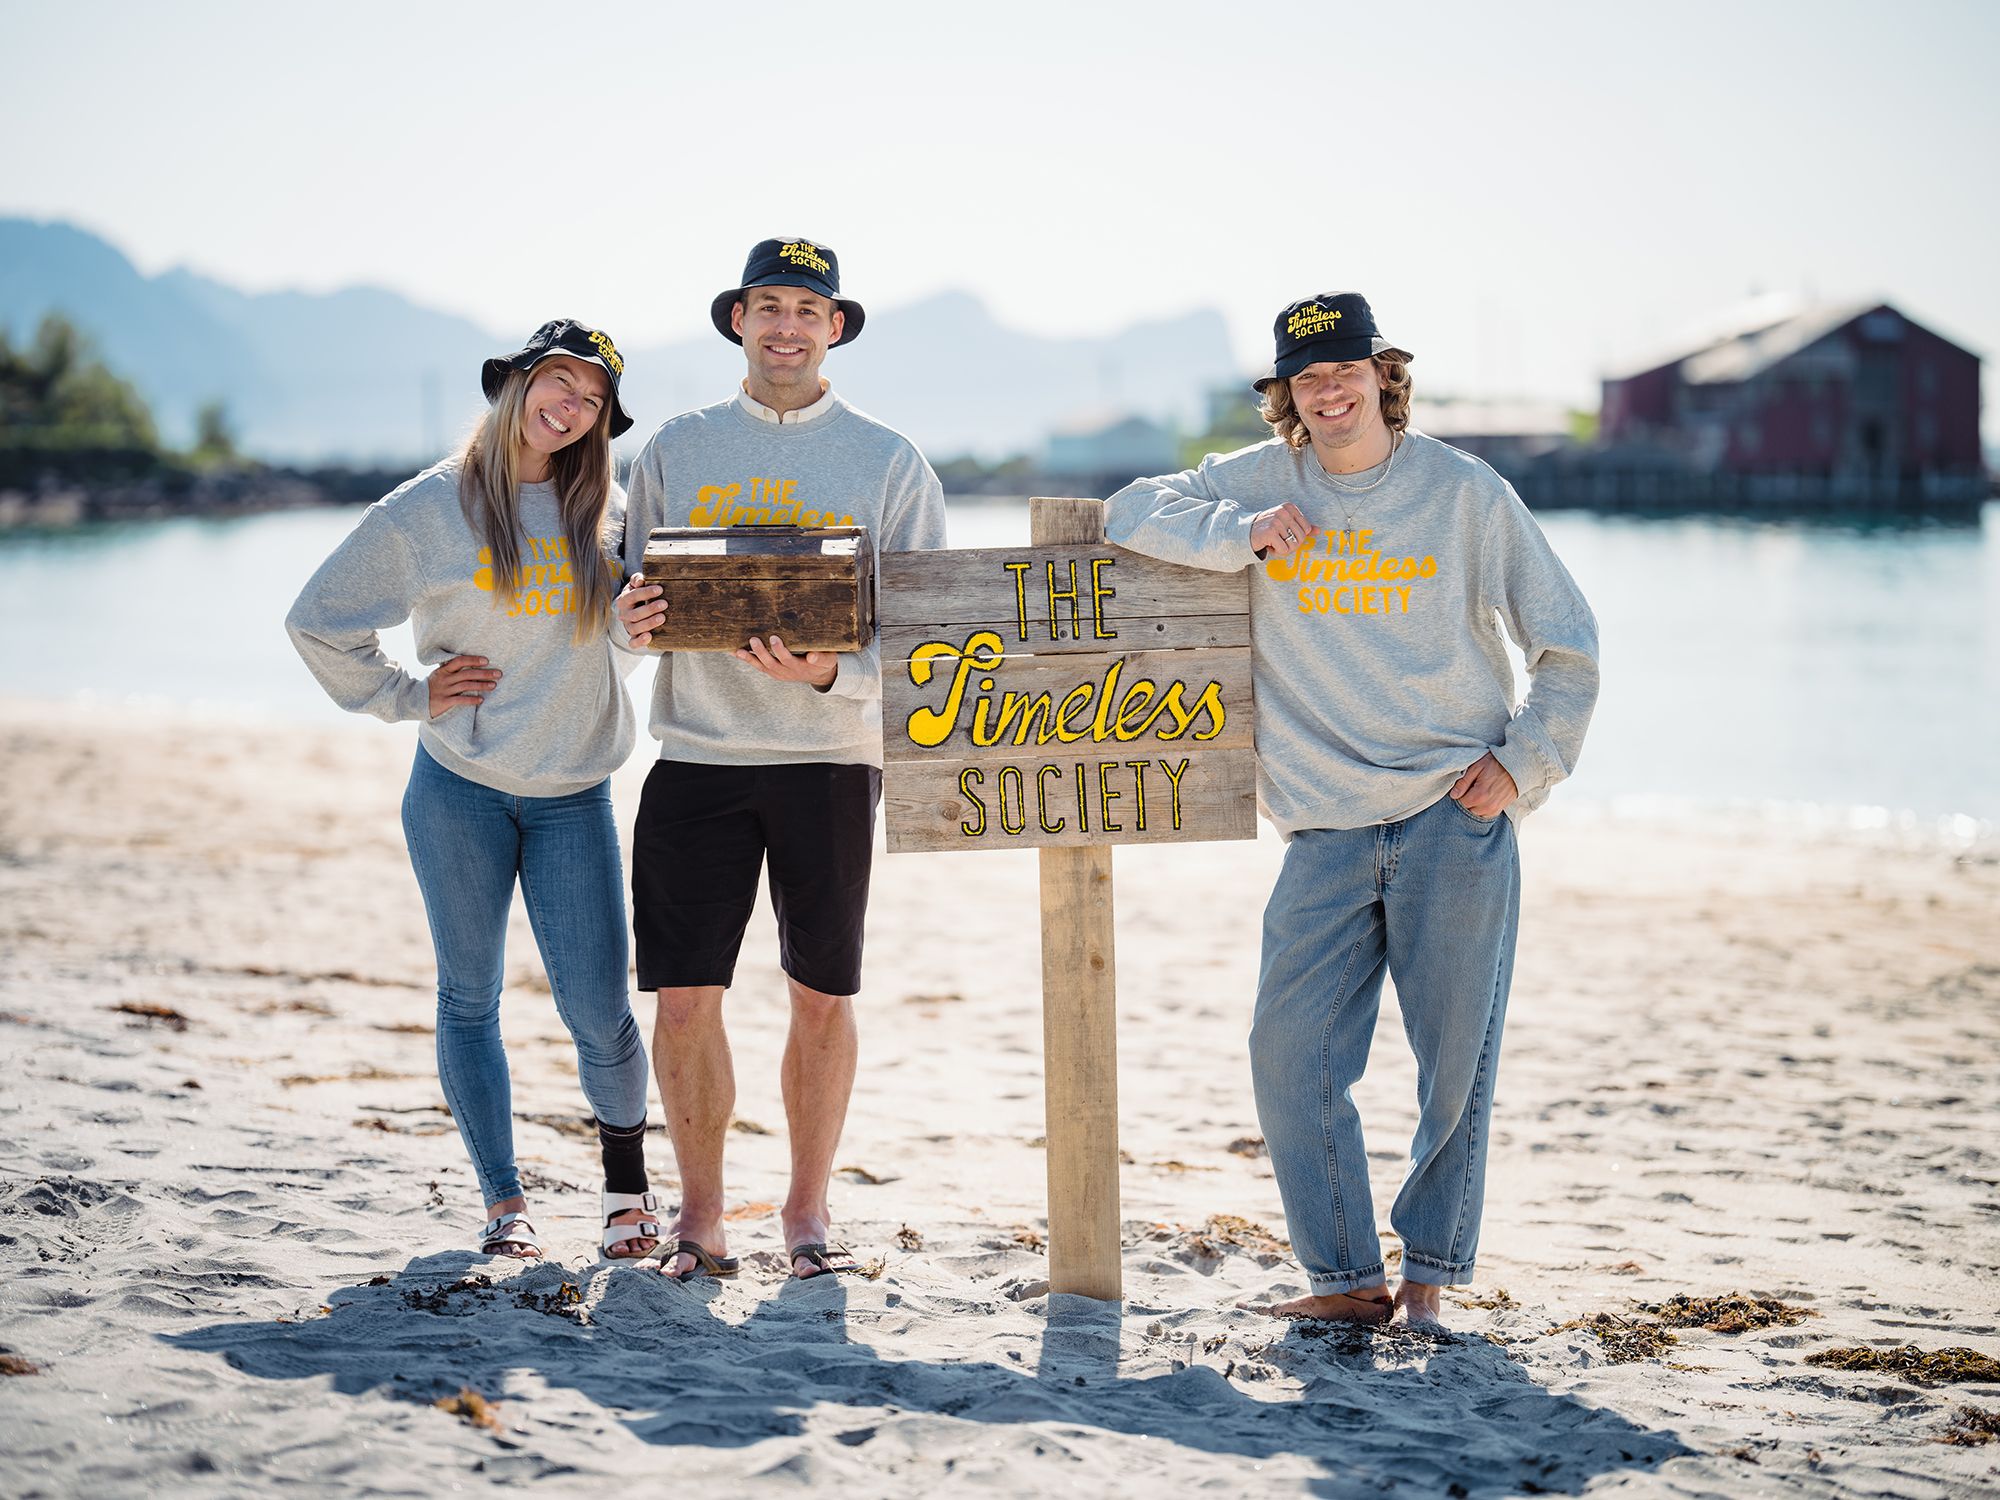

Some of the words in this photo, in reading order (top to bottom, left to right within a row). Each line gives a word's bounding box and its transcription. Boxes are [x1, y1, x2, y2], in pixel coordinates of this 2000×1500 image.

[800, 243, 816, 255] THE
[790, 256, 826, 275] SOCIETY
[1287, 310, 1342, 333] Timeless
[1301, 304, 1319, 317] THE
[1295, 320, 1335, 339] SOCIETY
[749, 477, 798, 505] THE
[1324, 529, 1374, 555] THE
[1004, 558, 1117, 642] THE
[1298, 585, 1411, 614] SOCIETY
[906, 630, 1226, 748] Timeless
[958, 758, 1190, 836] SOCIETY
